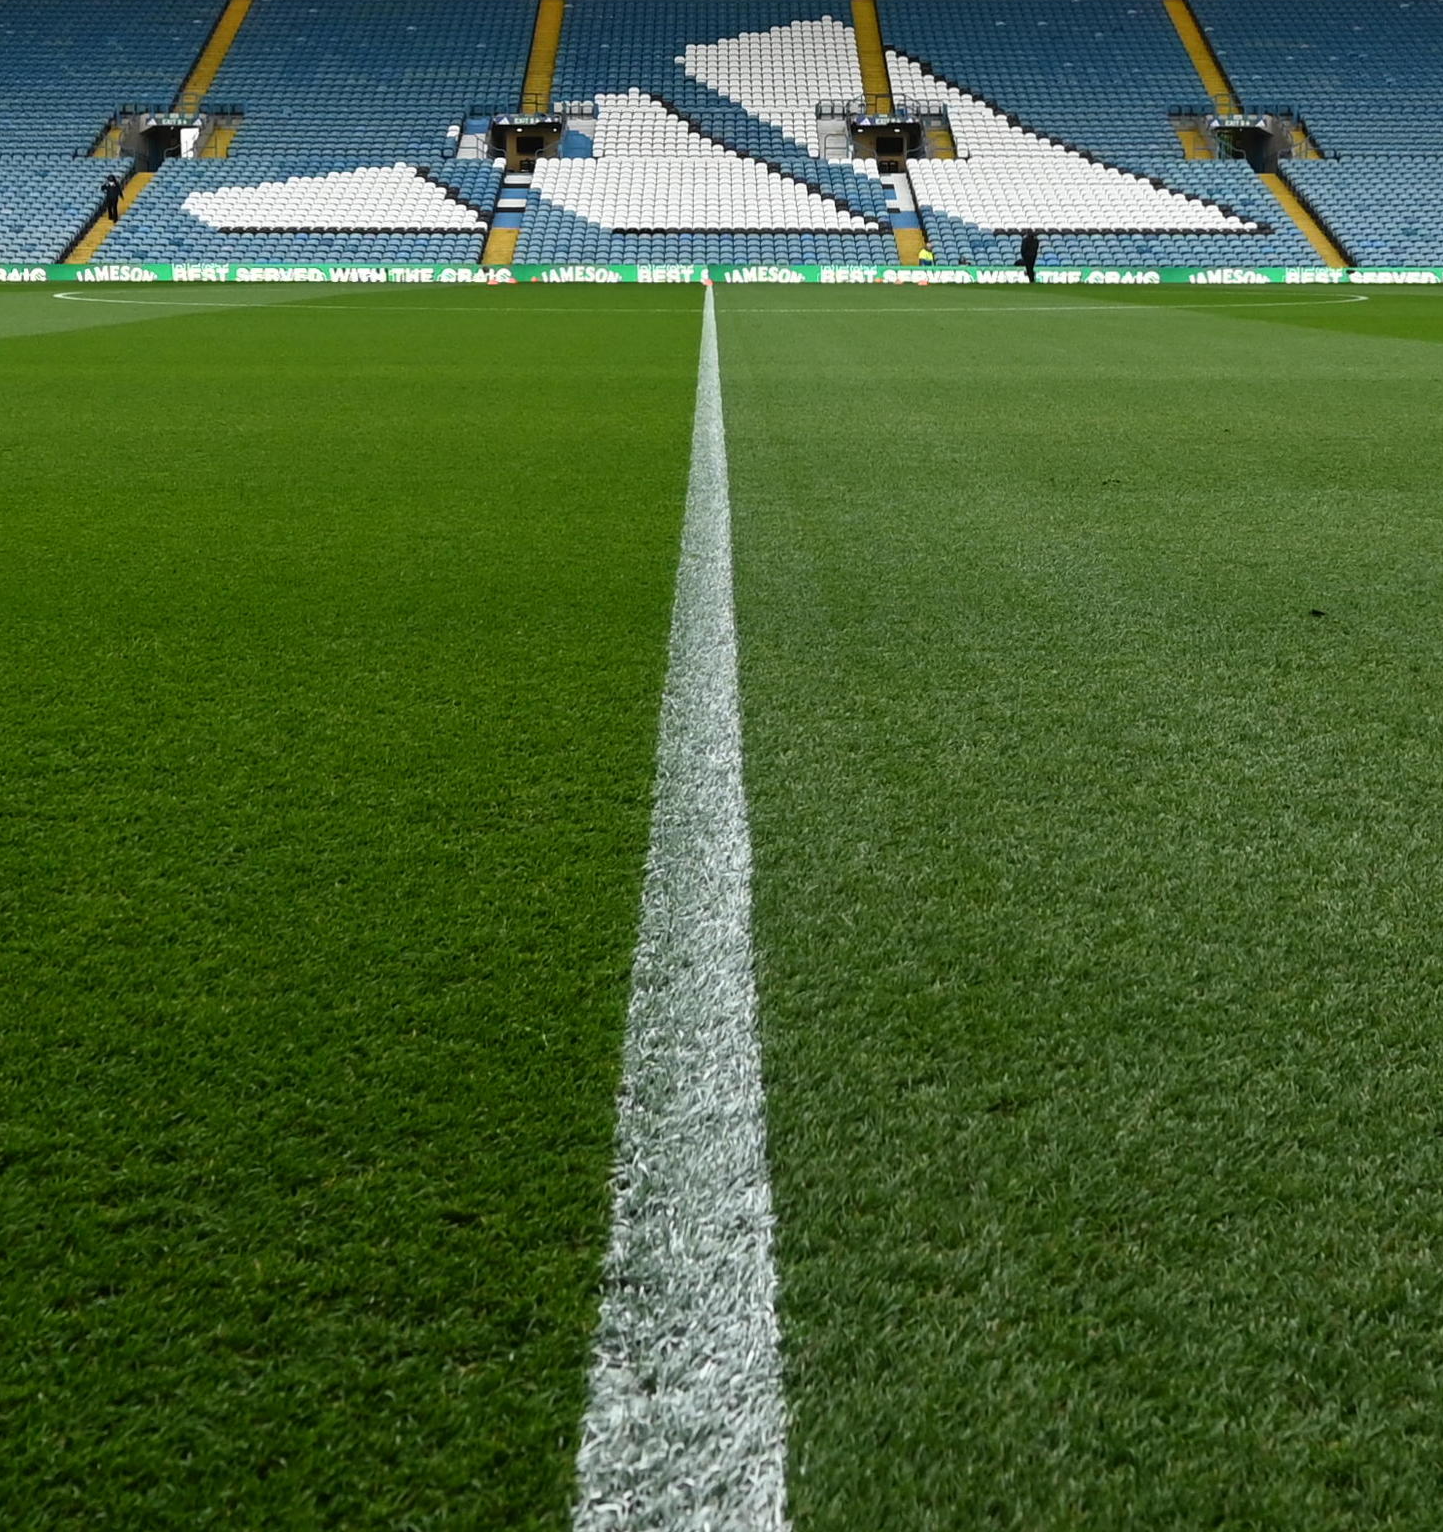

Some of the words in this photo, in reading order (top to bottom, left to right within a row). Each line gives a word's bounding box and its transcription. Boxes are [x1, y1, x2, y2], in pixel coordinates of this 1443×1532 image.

[77, 265, 157, 282] JAMESON
[542, 266, 623, 283] JAMESON
[725, 266, 805, 283] JAMESON
